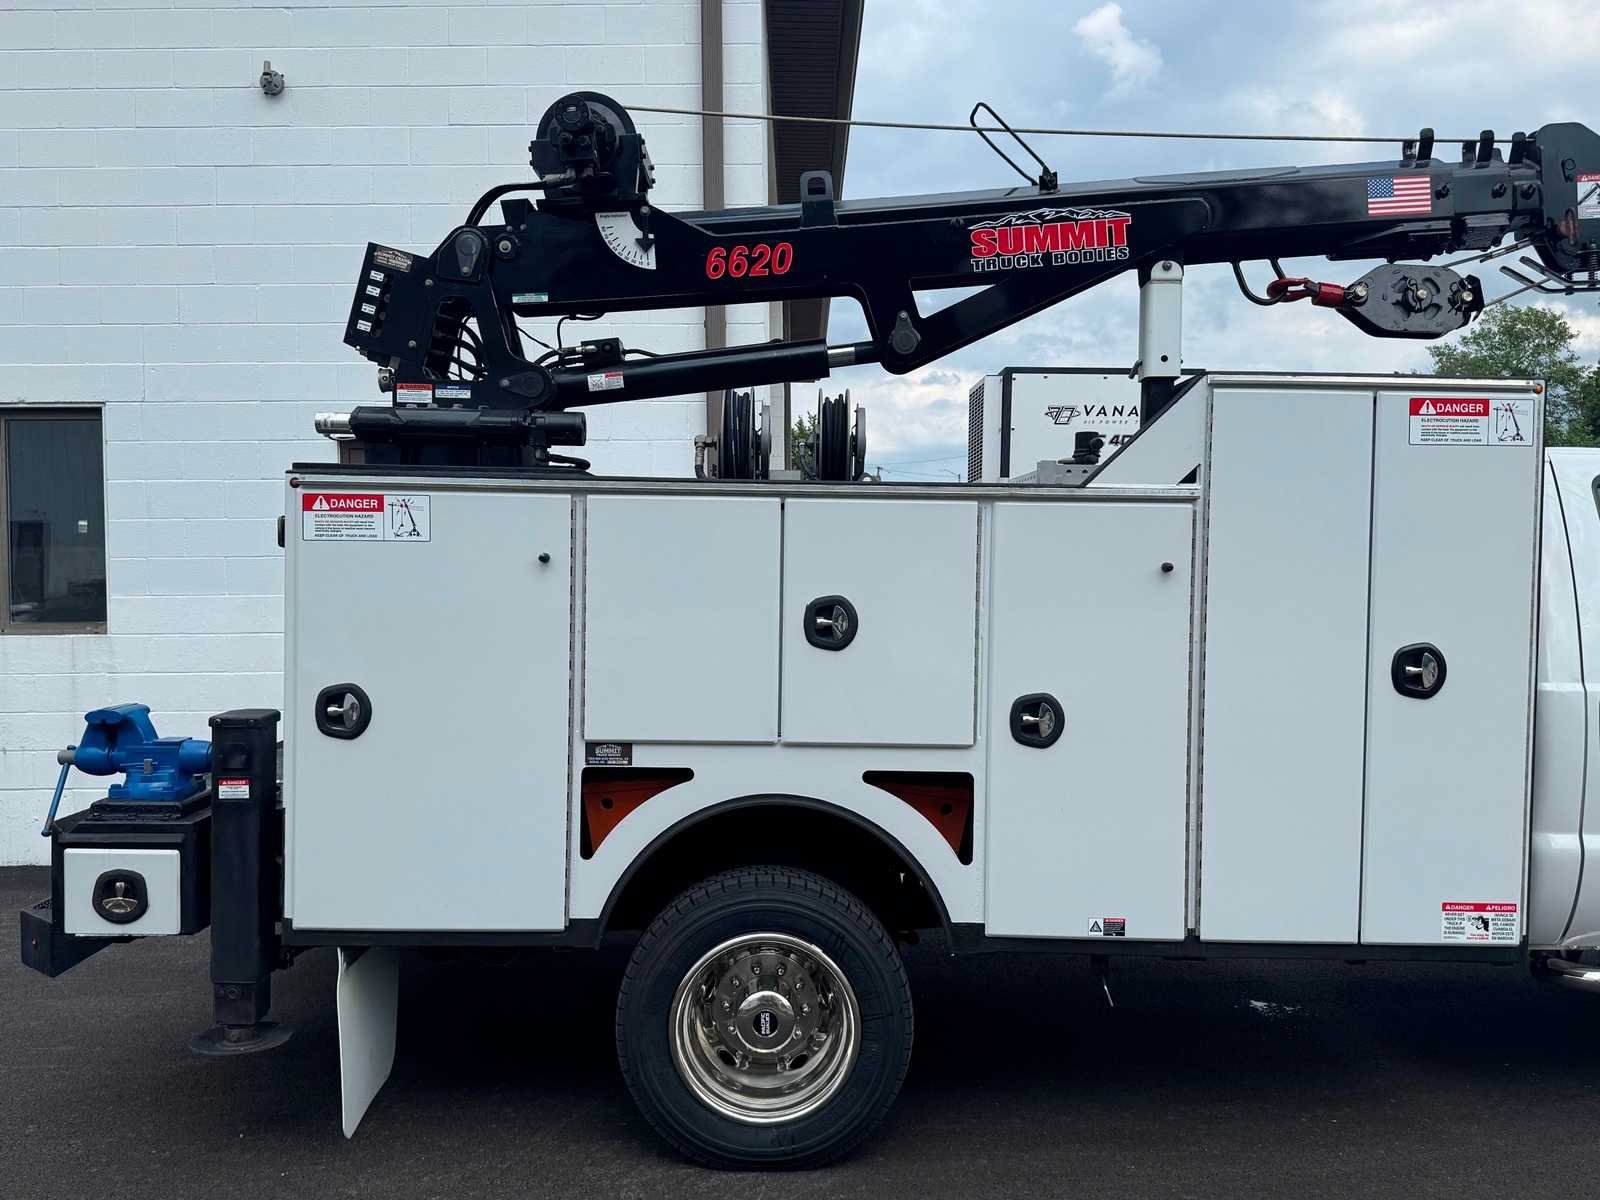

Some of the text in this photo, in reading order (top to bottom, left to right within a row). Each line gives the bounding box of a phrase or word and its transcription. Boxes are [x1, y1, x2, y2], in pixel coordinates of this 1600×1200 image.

[970, 217, 1132, 258] SUMMIT
[705, 242, 794, 280] 6620
[971, 247, 1130, 272] TRUCK BODIES
[1436, 403, 1484, 413] DANGER
[330, 498, 378, 509] DANGER
